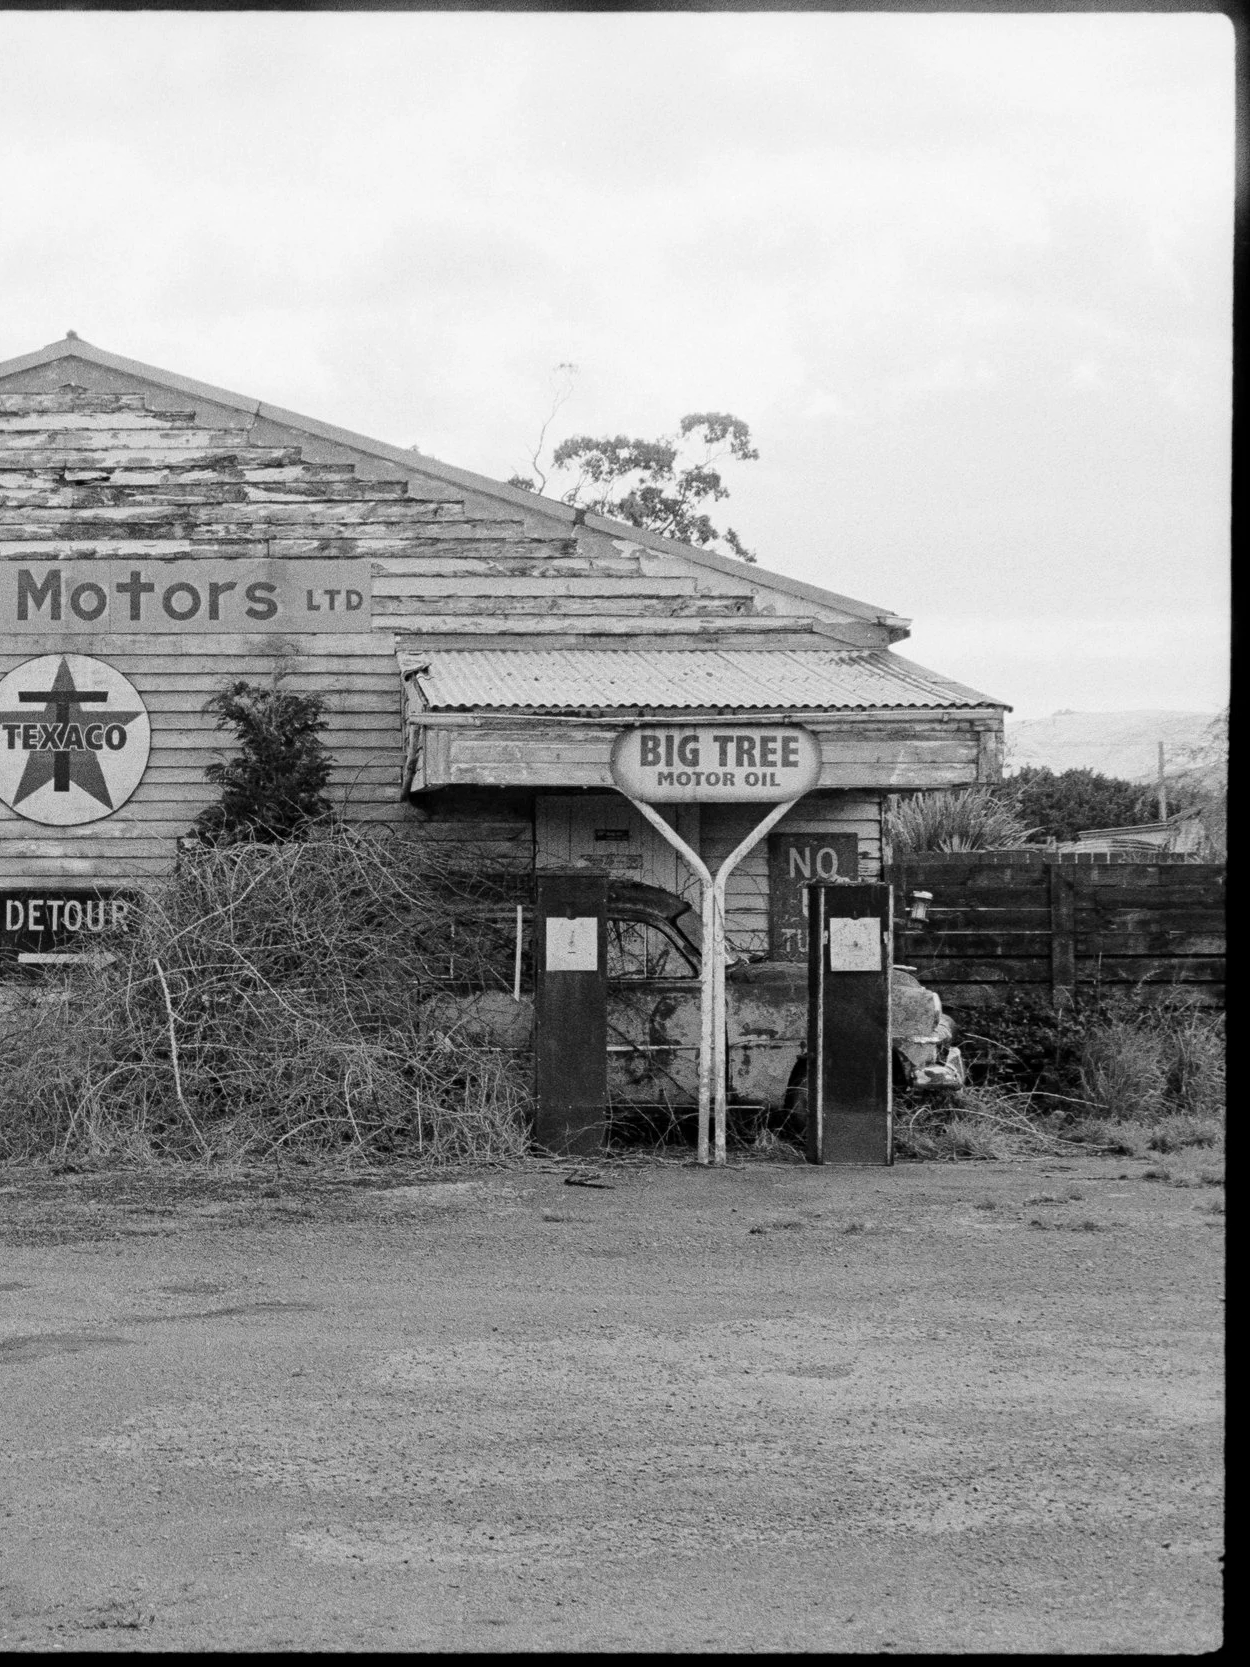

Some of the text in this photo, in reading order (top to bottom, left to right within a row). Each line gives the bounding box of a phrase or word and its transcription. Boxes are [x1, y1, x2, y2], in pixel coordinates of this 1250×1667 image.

[16, 568, 278, 621] Motors
[306, 589, 363, 611] LTD
[2, 722, 128, 751] TEXACO
[640, 734, 799, 768] BIG TREE
[657, 771, 781, 787] MOTOR OIL
[790, 847, 838, 879] NO
[6, 900, 128, 932] DETOUR
[781, 928, 809, 953] TU
